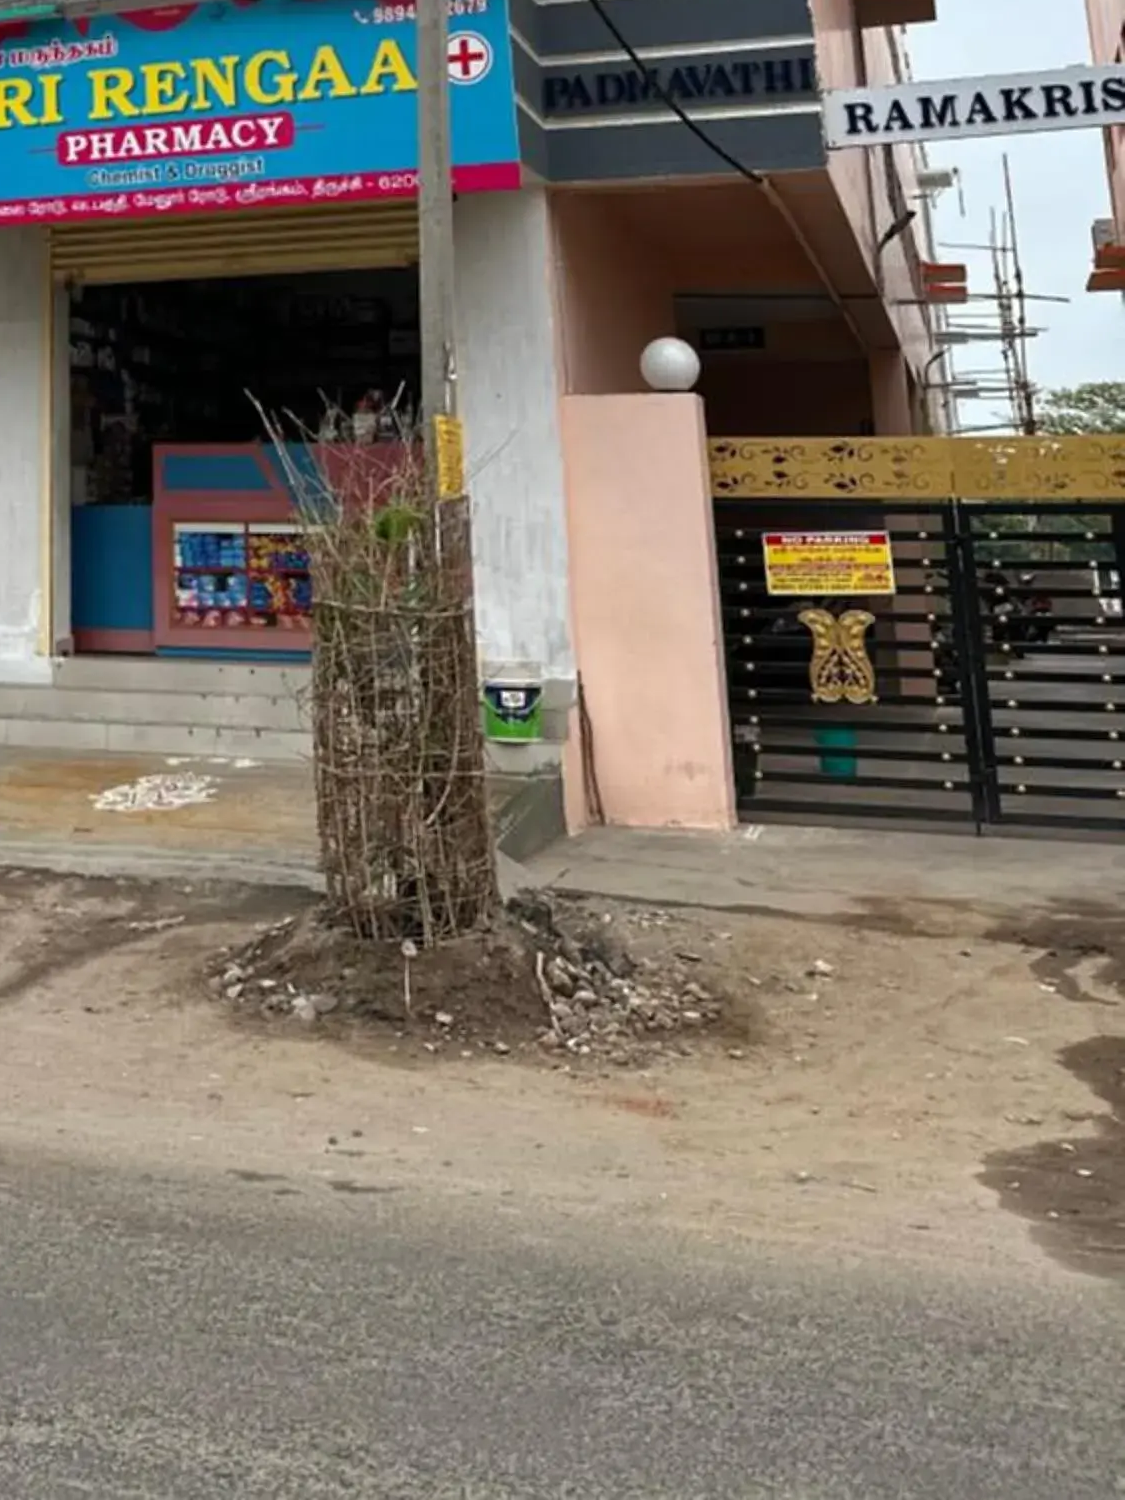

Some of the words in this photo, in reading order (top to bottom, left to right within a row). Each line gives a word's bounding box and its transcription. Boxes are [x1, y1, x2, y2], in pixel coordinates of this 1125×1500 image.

[87, 38, 418, 120] RENGAA
[541, 57, 817, 111] PADMAVATHI
[843, 77, 1125, 135] RAMAKRIS
[65, 116, 285, 162] PHARMACY
[87, 165, 160, 188] Chemist
[167, 162, 178, 180] &
[184, 154, 264, 181] Druggist
